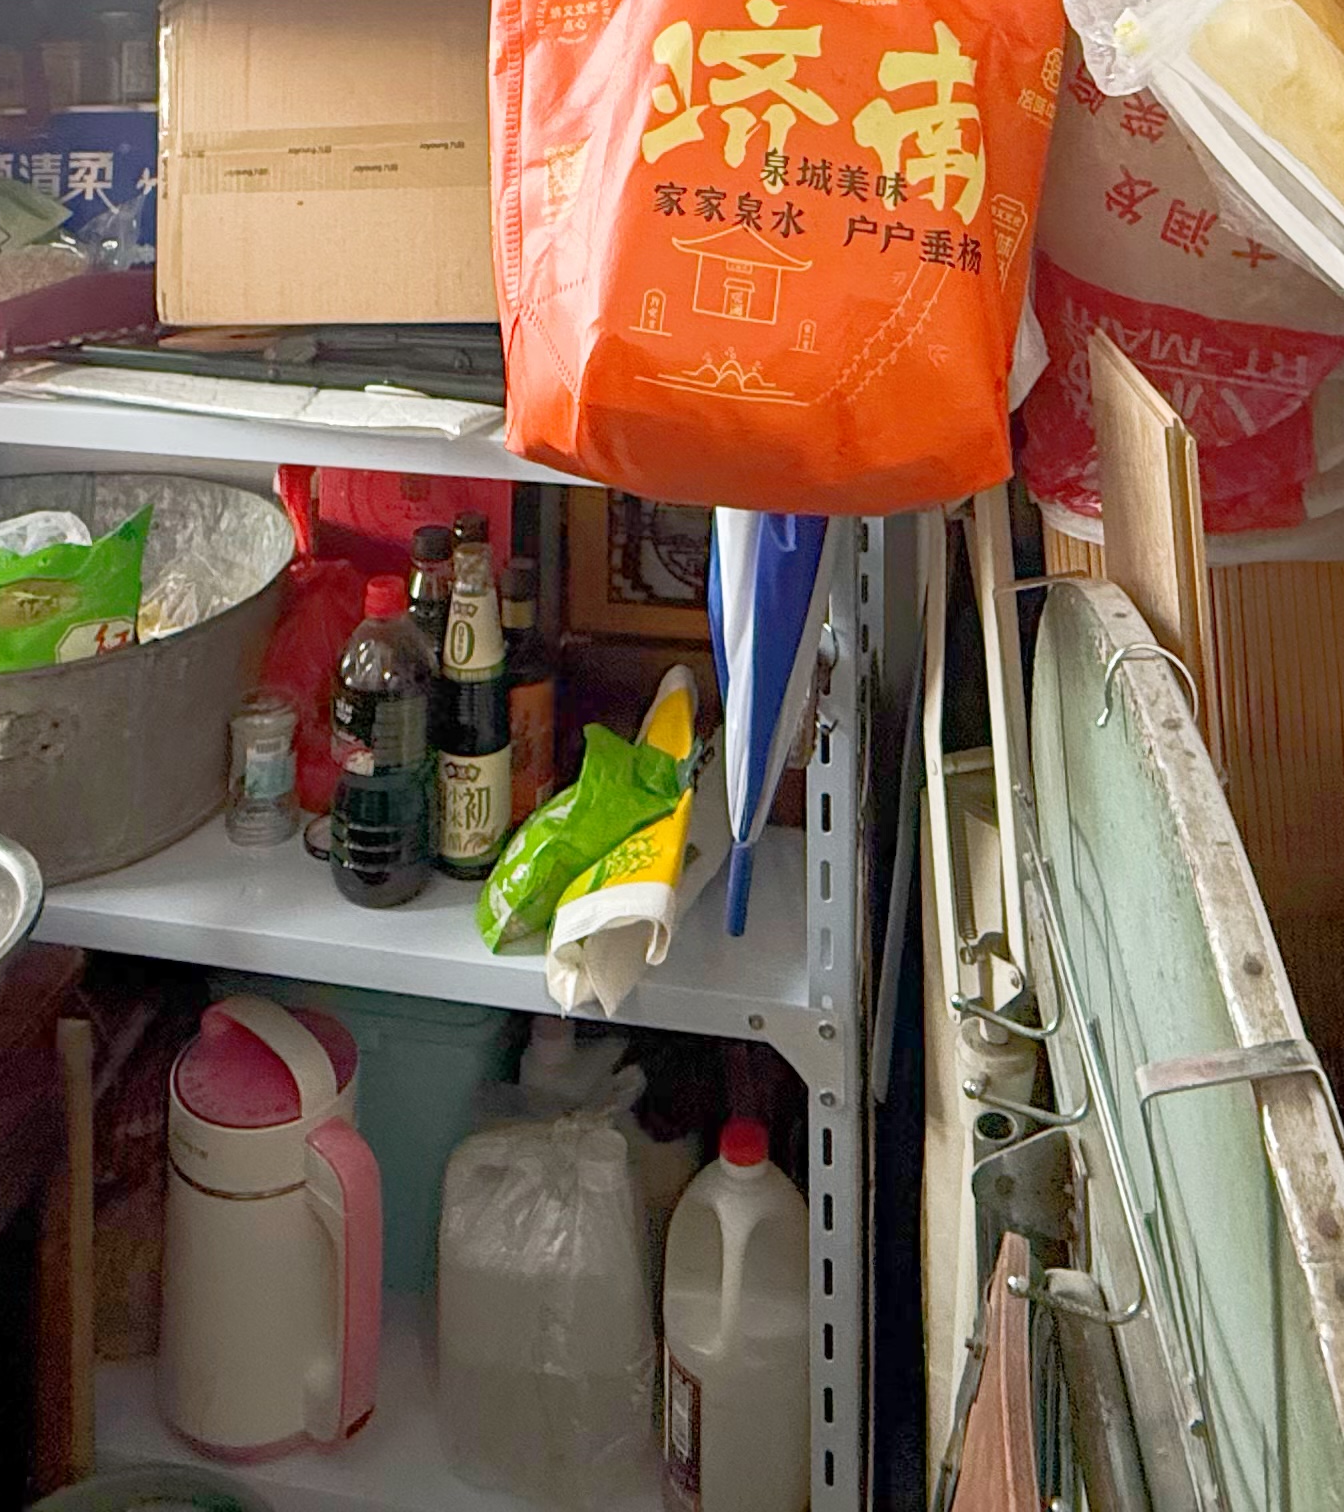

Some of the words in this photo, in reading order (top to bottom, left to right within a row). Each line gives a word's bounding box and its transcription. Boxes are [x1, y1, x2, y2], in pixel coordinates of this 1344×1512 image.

[761, 148, 909, 207] 泉城美味
[651, 181, 806, 238] 家家泉水
[842, 215, 982, 273] 户户垂杨
[464, 786, 491, 832] 初
